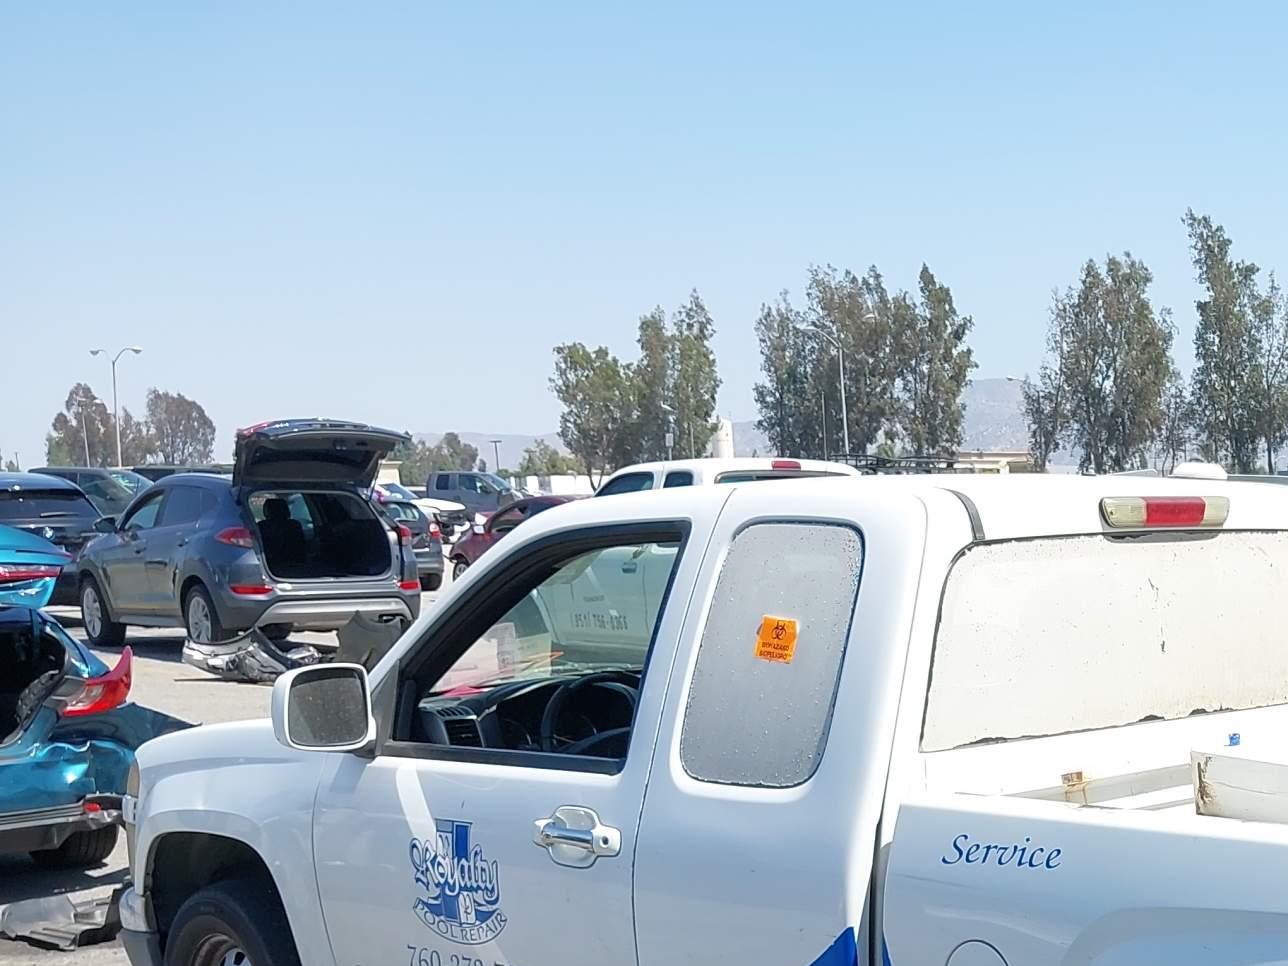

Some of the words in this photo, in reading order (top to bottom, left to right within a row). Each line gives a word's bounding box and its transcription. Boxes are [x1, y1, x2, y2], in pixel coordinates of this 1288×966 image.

[409, 837, 500, 906] Royalty
[941, 834, 1062, 869] Service
[413, 899, 459, 938] POOL
[460, 911, 508, 942] REPAIR
